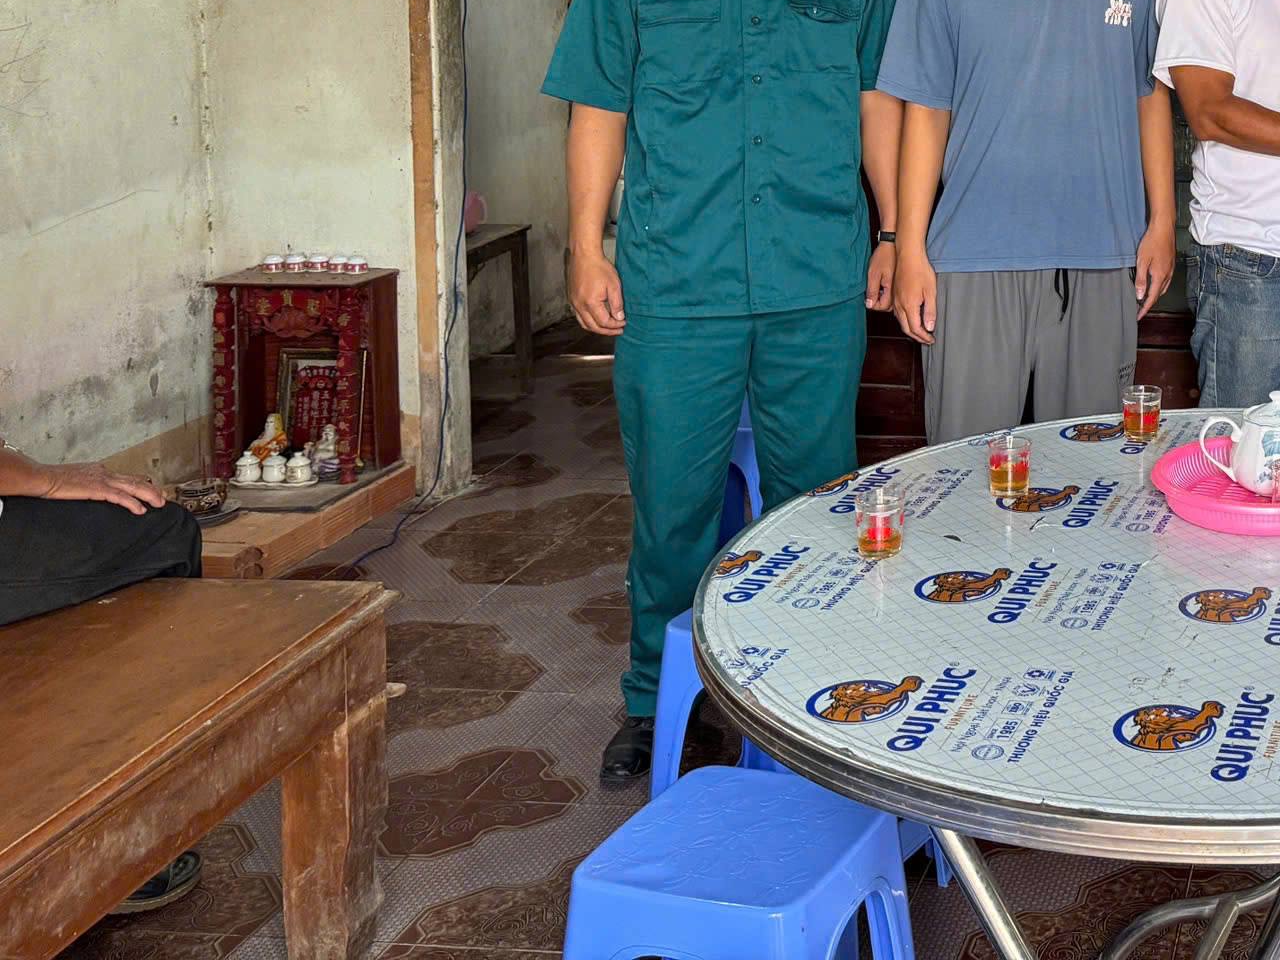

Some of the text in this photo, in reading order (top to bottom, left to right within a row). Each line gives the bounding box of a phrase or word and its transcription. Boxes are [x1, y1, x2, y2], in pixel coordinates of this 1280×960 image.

[1078, 480, 1119, 506] PHUC
[1062, 507, 1098, 528] QUI
[723, 545, 810, 602] QUI PHUC
[987, 562, 1058, 624] QUI PHUC
[1042, 685, 1065, 707] QUỐC
[1058, 671, 1074, 683] GIA
[886, 667, 976, 751] QUI PHUC
[943, 694, 978, 729] FURNITURE
[996, 721, 1018, 738] 1985
[1210, 692, 1274, 782] QUI PHUC
